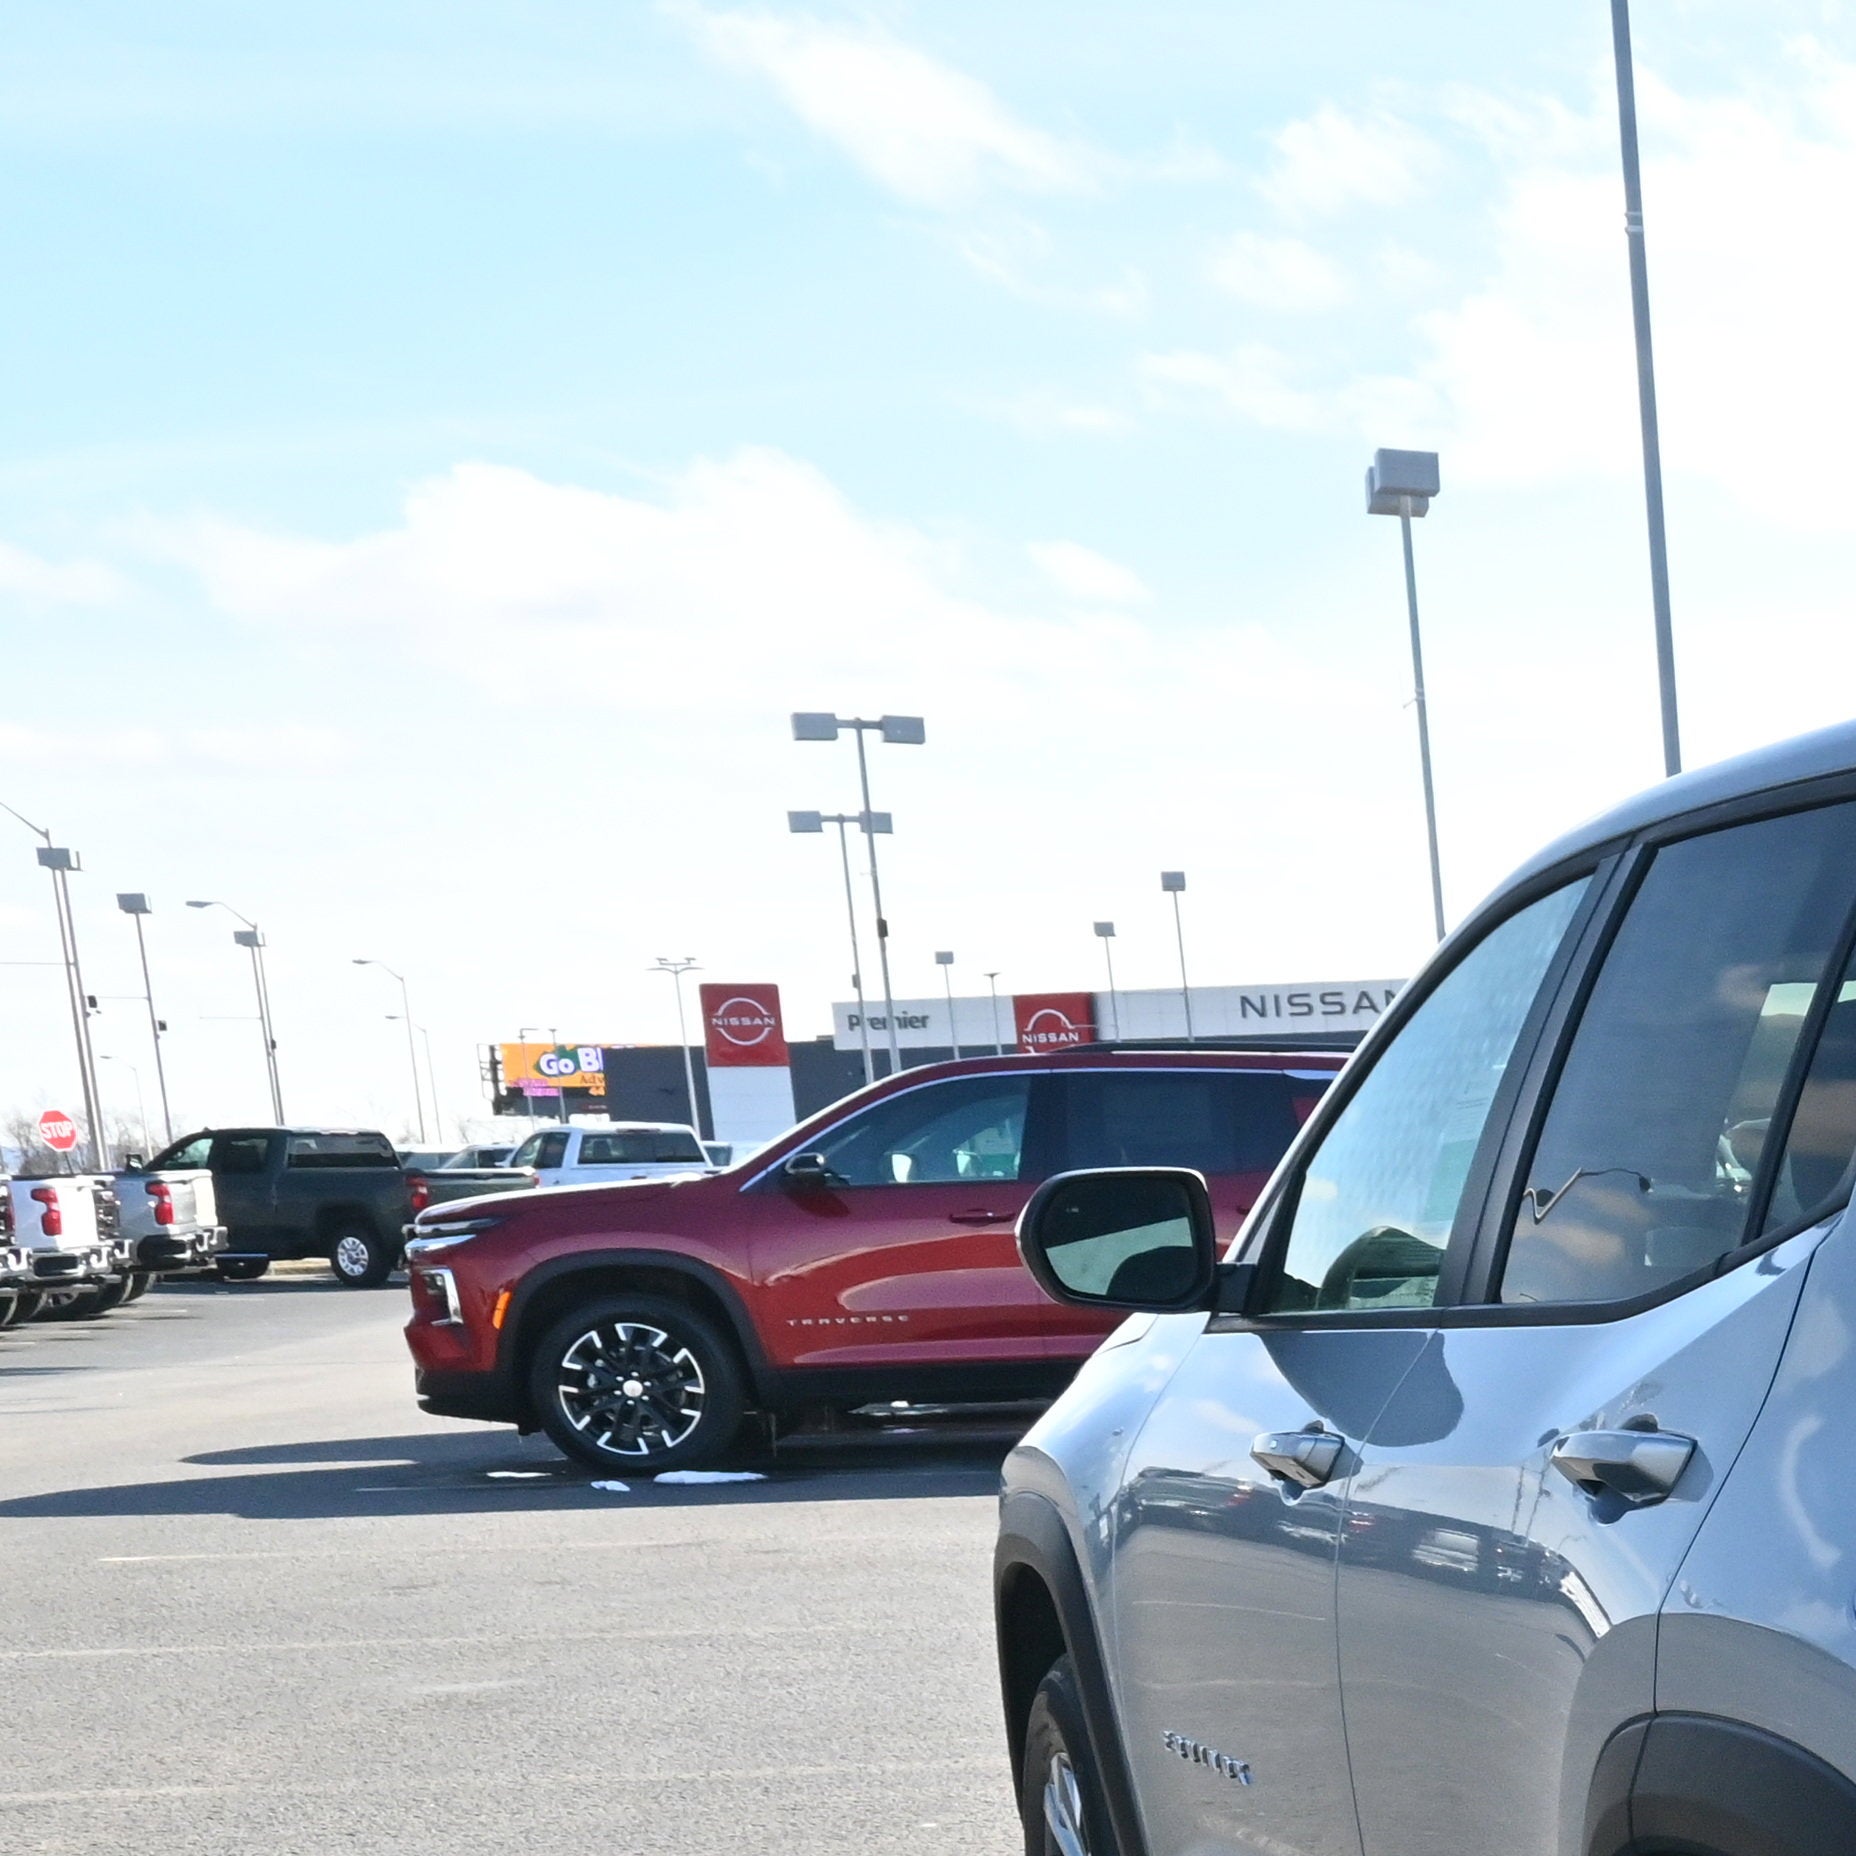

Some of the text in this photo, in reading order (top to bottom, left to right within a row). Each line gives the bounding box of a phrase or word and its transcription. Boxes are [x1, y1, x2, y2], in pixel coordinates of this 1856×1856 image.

[712, 1017, 776, 1026] NISSAN
[1022, 1032, 1079, 1043] NISSAN
[540, 1053, 575, 1075] Go
[40, 1121, 73, 1139] STOP
